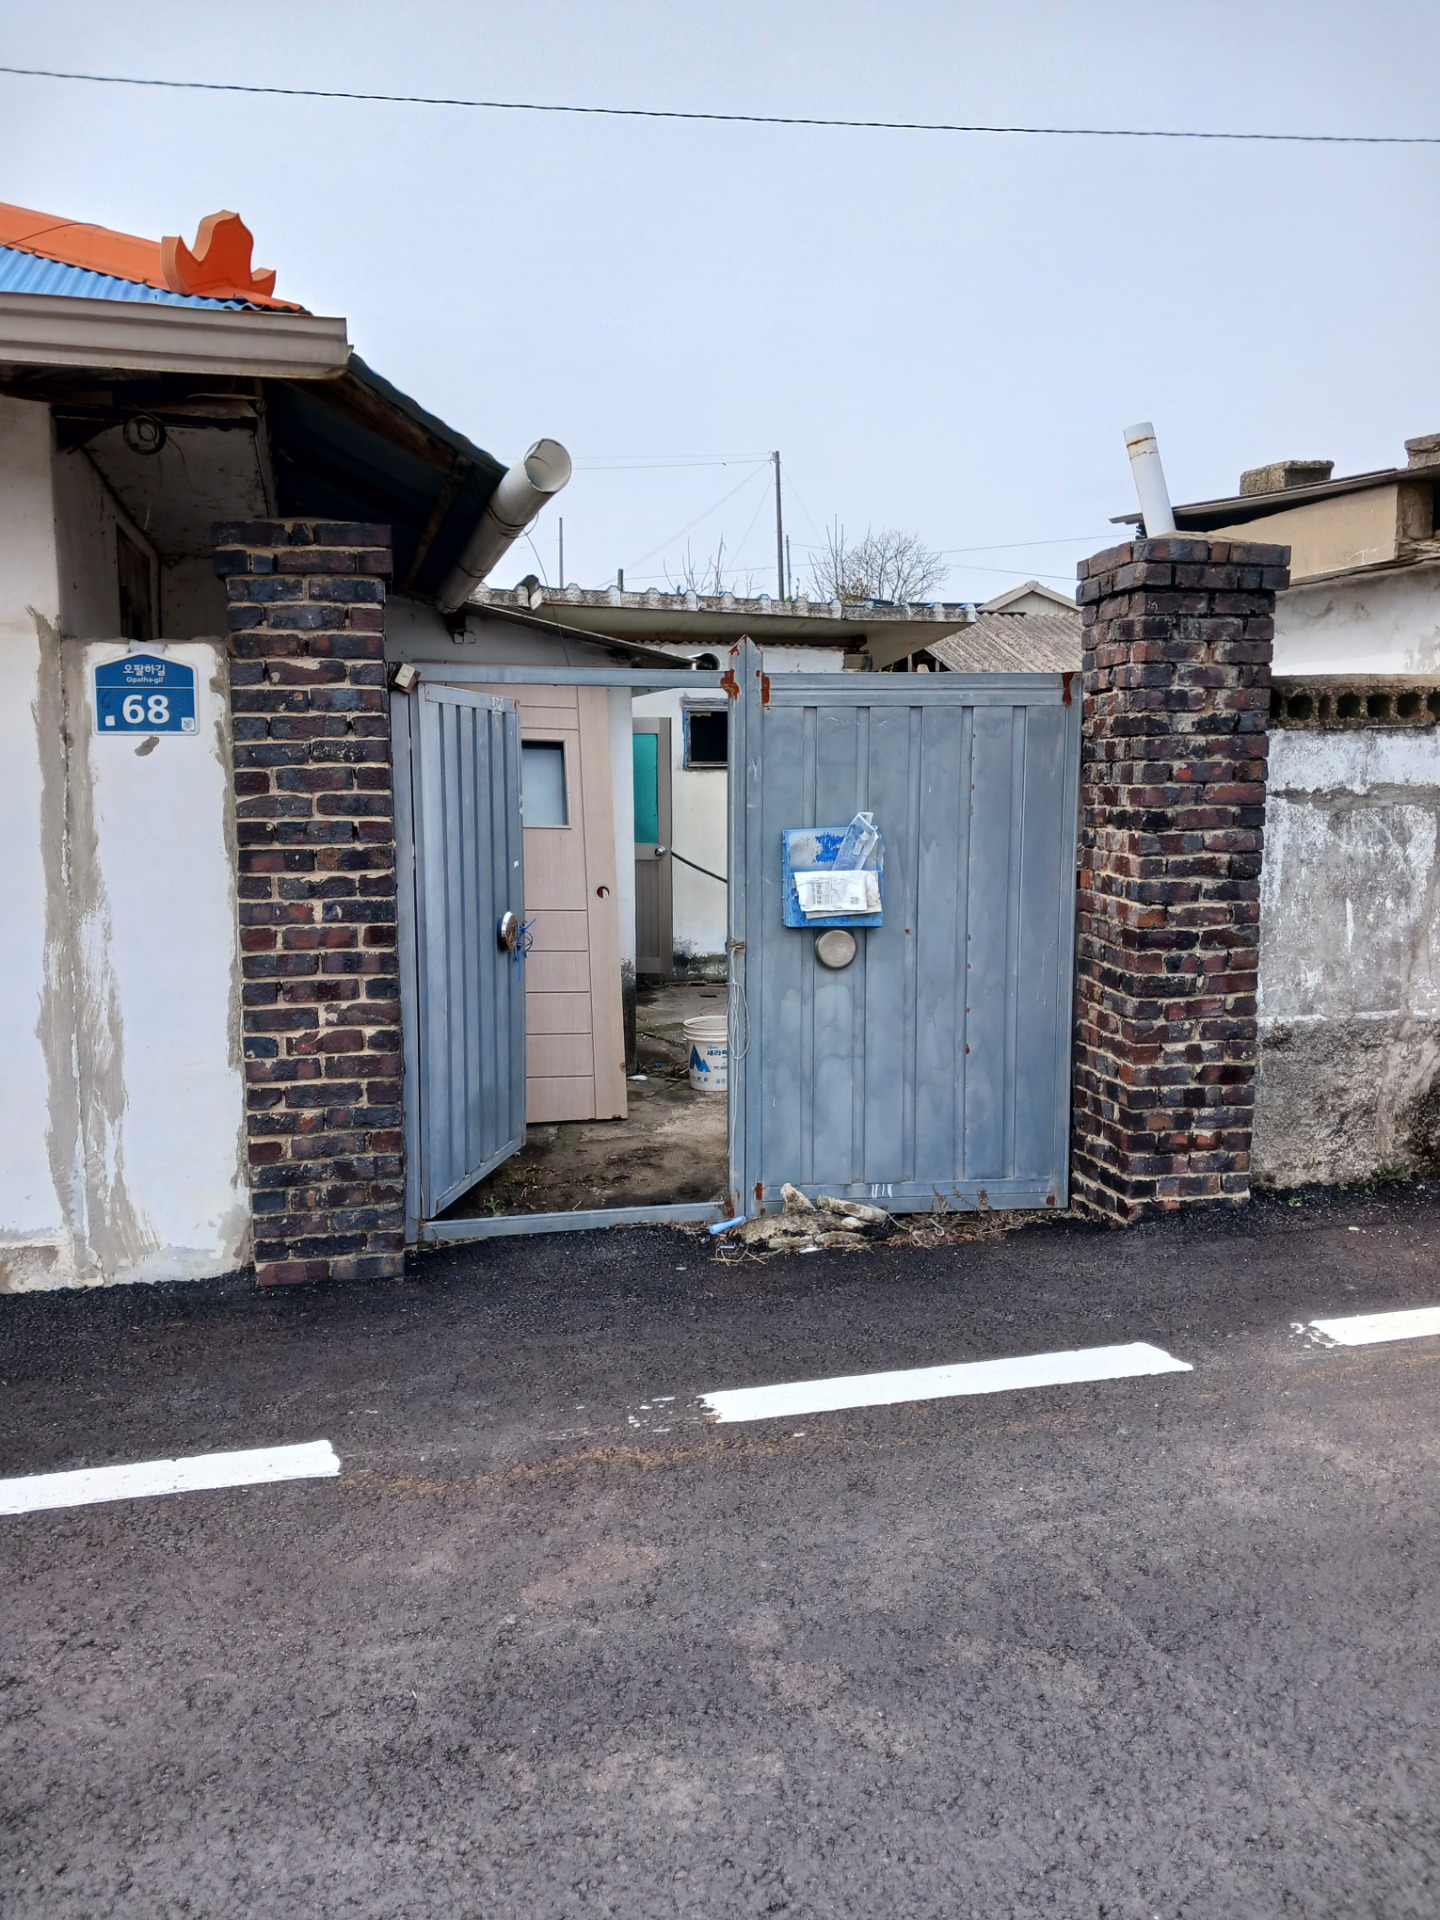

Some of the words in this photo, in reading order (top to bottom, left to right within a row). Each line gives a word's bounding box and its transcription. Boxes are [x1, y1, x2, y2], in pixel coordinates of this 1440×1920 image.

[122, 664, 166, 676] 오팔하길
[126, 676, 164, 684] Opalha-gil
[122, 694, 170, 724] 68
